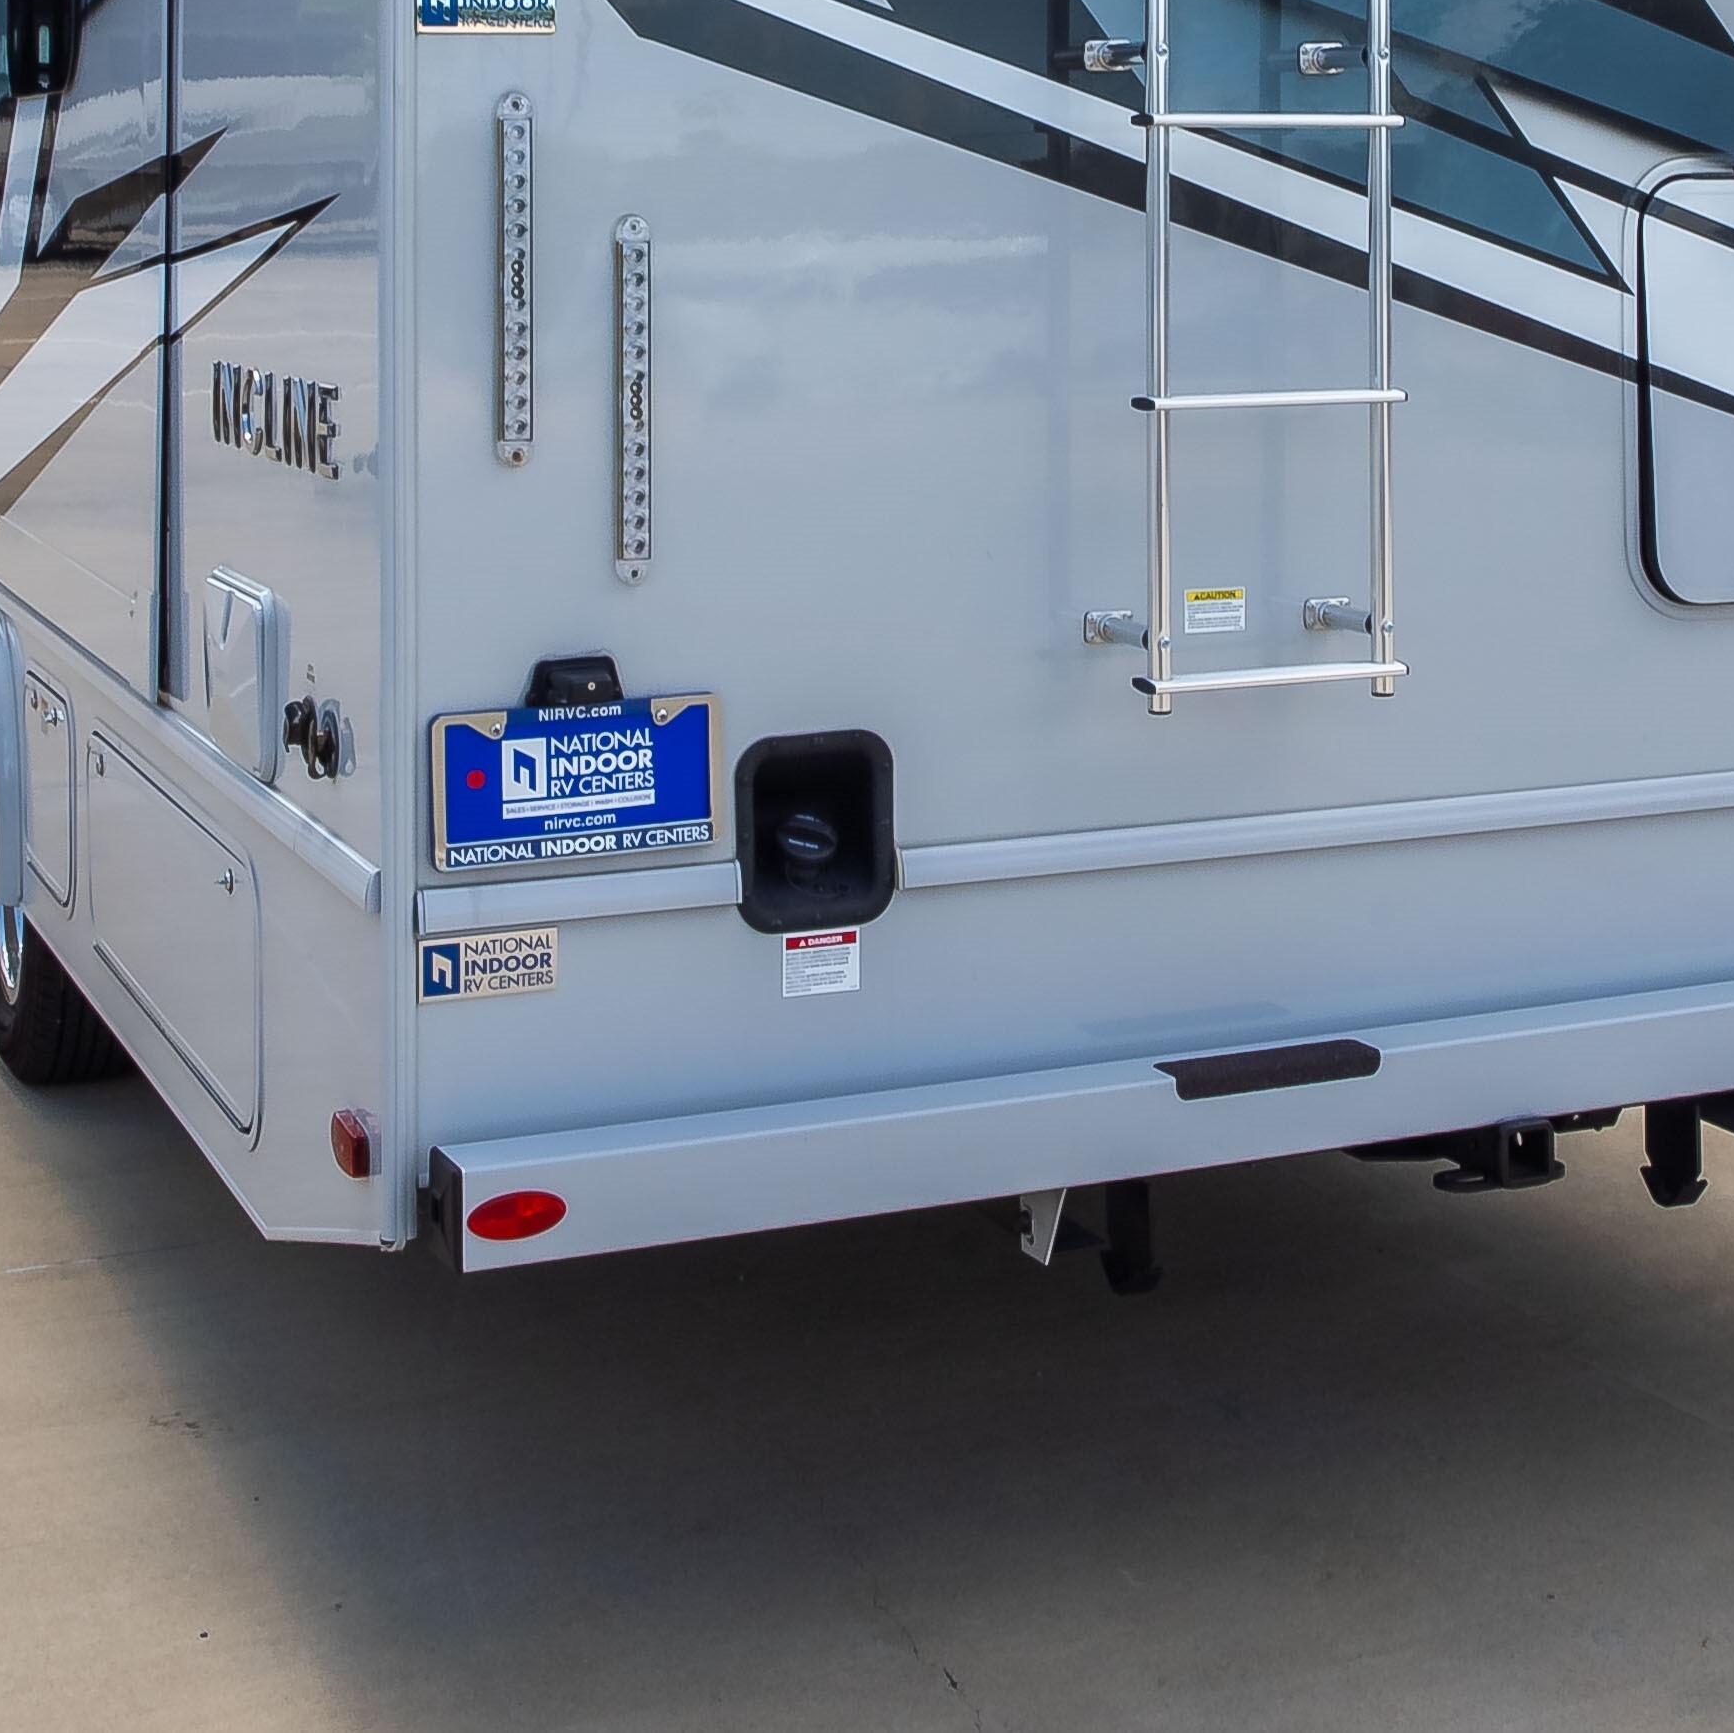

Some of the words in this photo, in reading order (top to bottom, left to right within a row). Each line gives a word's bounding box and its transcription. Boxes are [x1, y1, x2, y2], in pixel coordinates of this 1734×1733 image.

[212, 359, 340, 480] INCLINE
[538, 704, 622, 722] NIRVC.com
[550, 727, 654, 756] NATIONAL
[551, 748, 654, 778] INDOOR
[550, 777, 575, 797] RV
[578, 769, 655, 794] CENTERS
[544, 813, 617, 831] nirvc.com
[450, 842, 535, 866] NATIONAL
[541, 834, 617, 857] INDOOR
[623, 831, 643, 848] RV
[645, 824, 710, 846] CENTERS
[464, 933, 553, 958] NATIONAL
[807, 935, 843, 946] DANGER
[464, 952, 553, 977] INDOOR
[464, 977, 484, 993] RV
[488, 970, 554, 991] CENTERS
